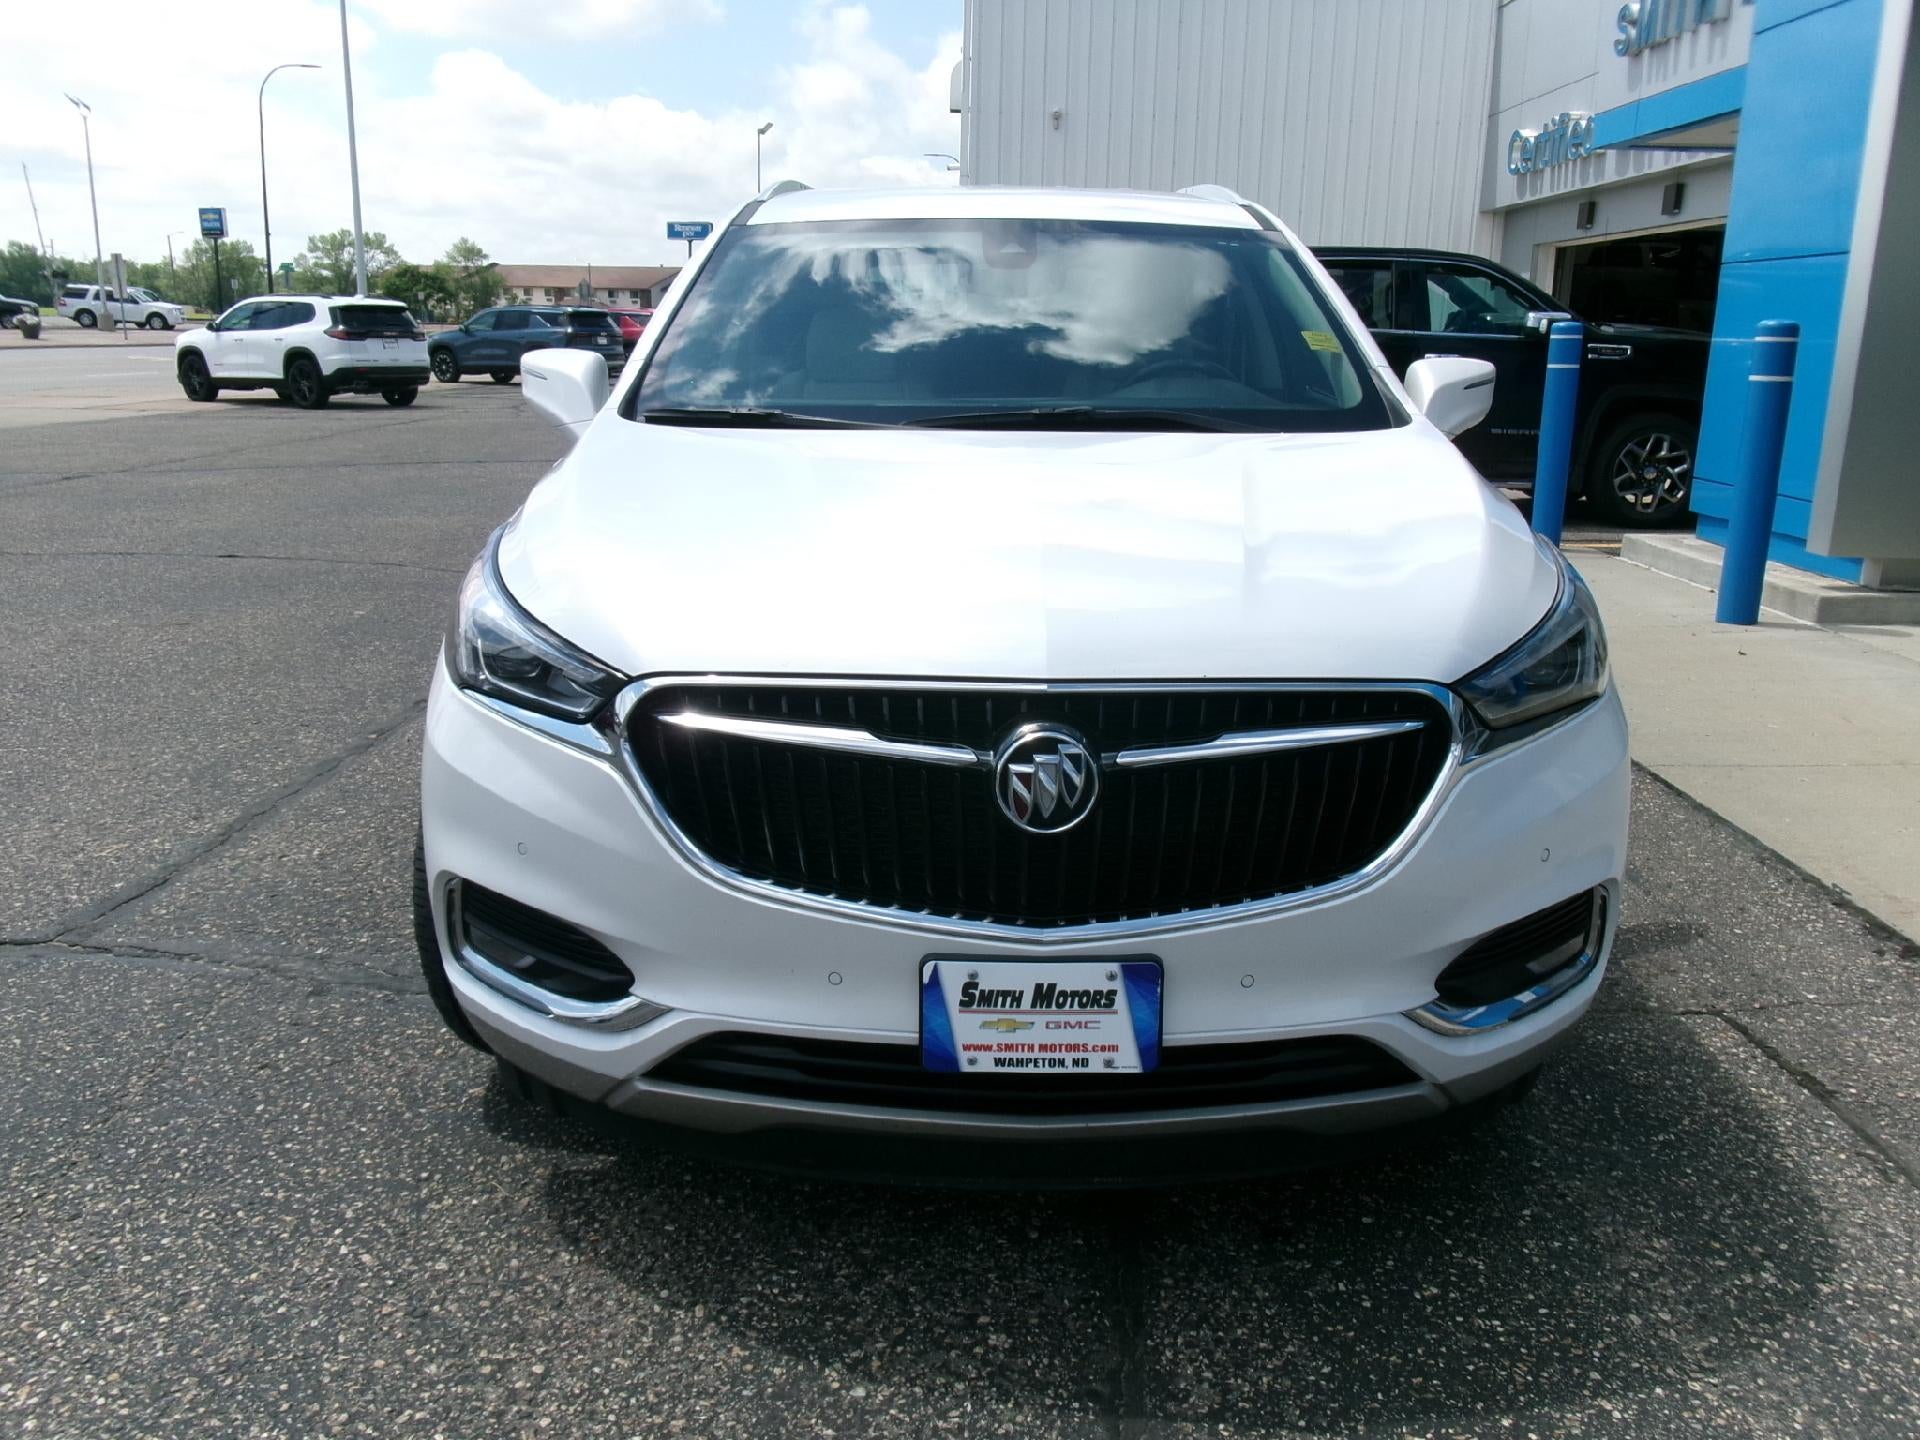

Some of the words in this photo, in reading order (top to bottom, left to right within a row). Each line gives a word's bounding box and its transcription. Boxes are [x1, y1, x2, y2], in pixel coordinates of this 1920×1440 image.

[1045, 1020, 1101, 1030] GMC
[993, 1057, 1068, 1069] WAHPETON,
[1072, 1057, 1089, 1068] ND
